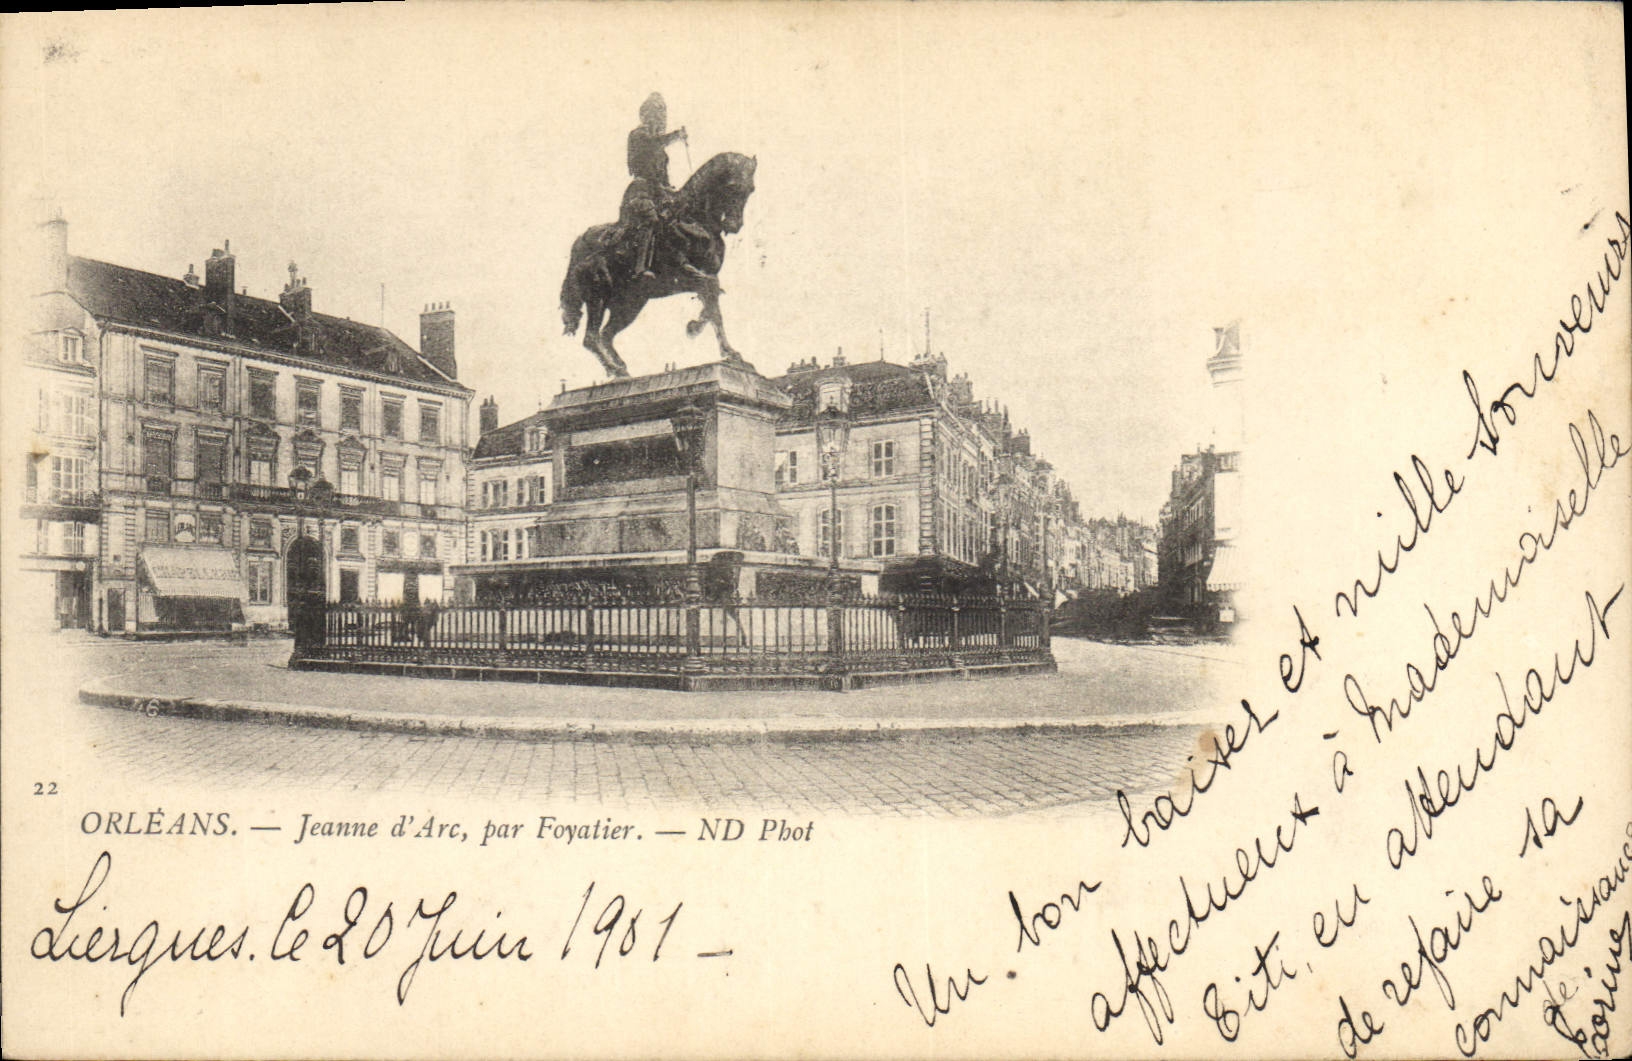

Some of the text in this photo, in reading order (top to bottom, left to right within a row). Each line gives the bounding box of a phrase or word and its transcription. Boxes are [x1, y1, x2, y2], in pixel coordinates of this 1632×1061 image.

[893, 963, 988, 1027] Un
[1009, 881, 1102, 953] bon
[1280, 605, 1321, 693] et
[1336, 454, 1464, 617] mille
[1322, 730, 1354, 793] à
[323, 886, 394, 965] 20
[397, 891, 533, 1006] Juin
[561, 881, 683, 969] 1901
[1313, 884, 1371, 948] en
[1338, 995, 1384, 1060] de
[1519, 796, 1583, 858] sa
